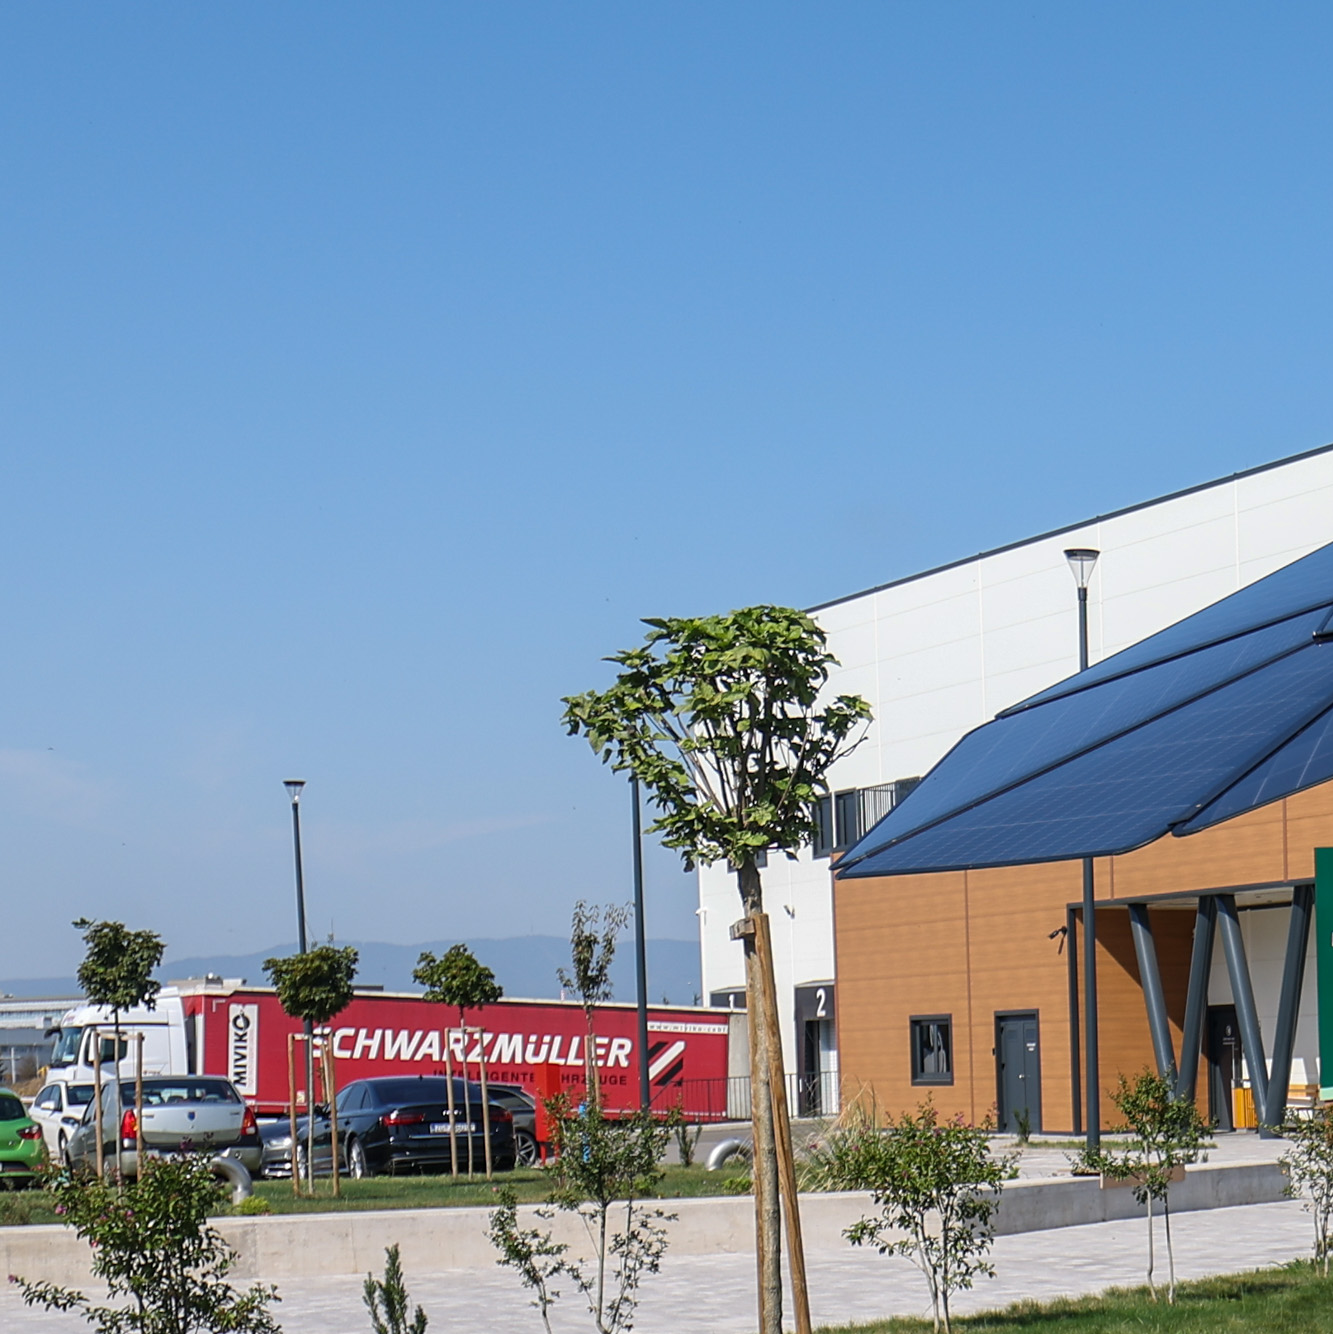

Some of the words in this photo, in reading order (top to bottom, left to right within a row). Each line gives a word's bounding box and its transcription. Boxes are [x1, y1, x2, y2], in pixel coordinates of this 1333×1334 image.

[815, 988, 826, 1018] 2
[232, 1009, 251, 1087] MIVIKO
[311, 1026, 633, 1068] SCHWARZMÜLLER
